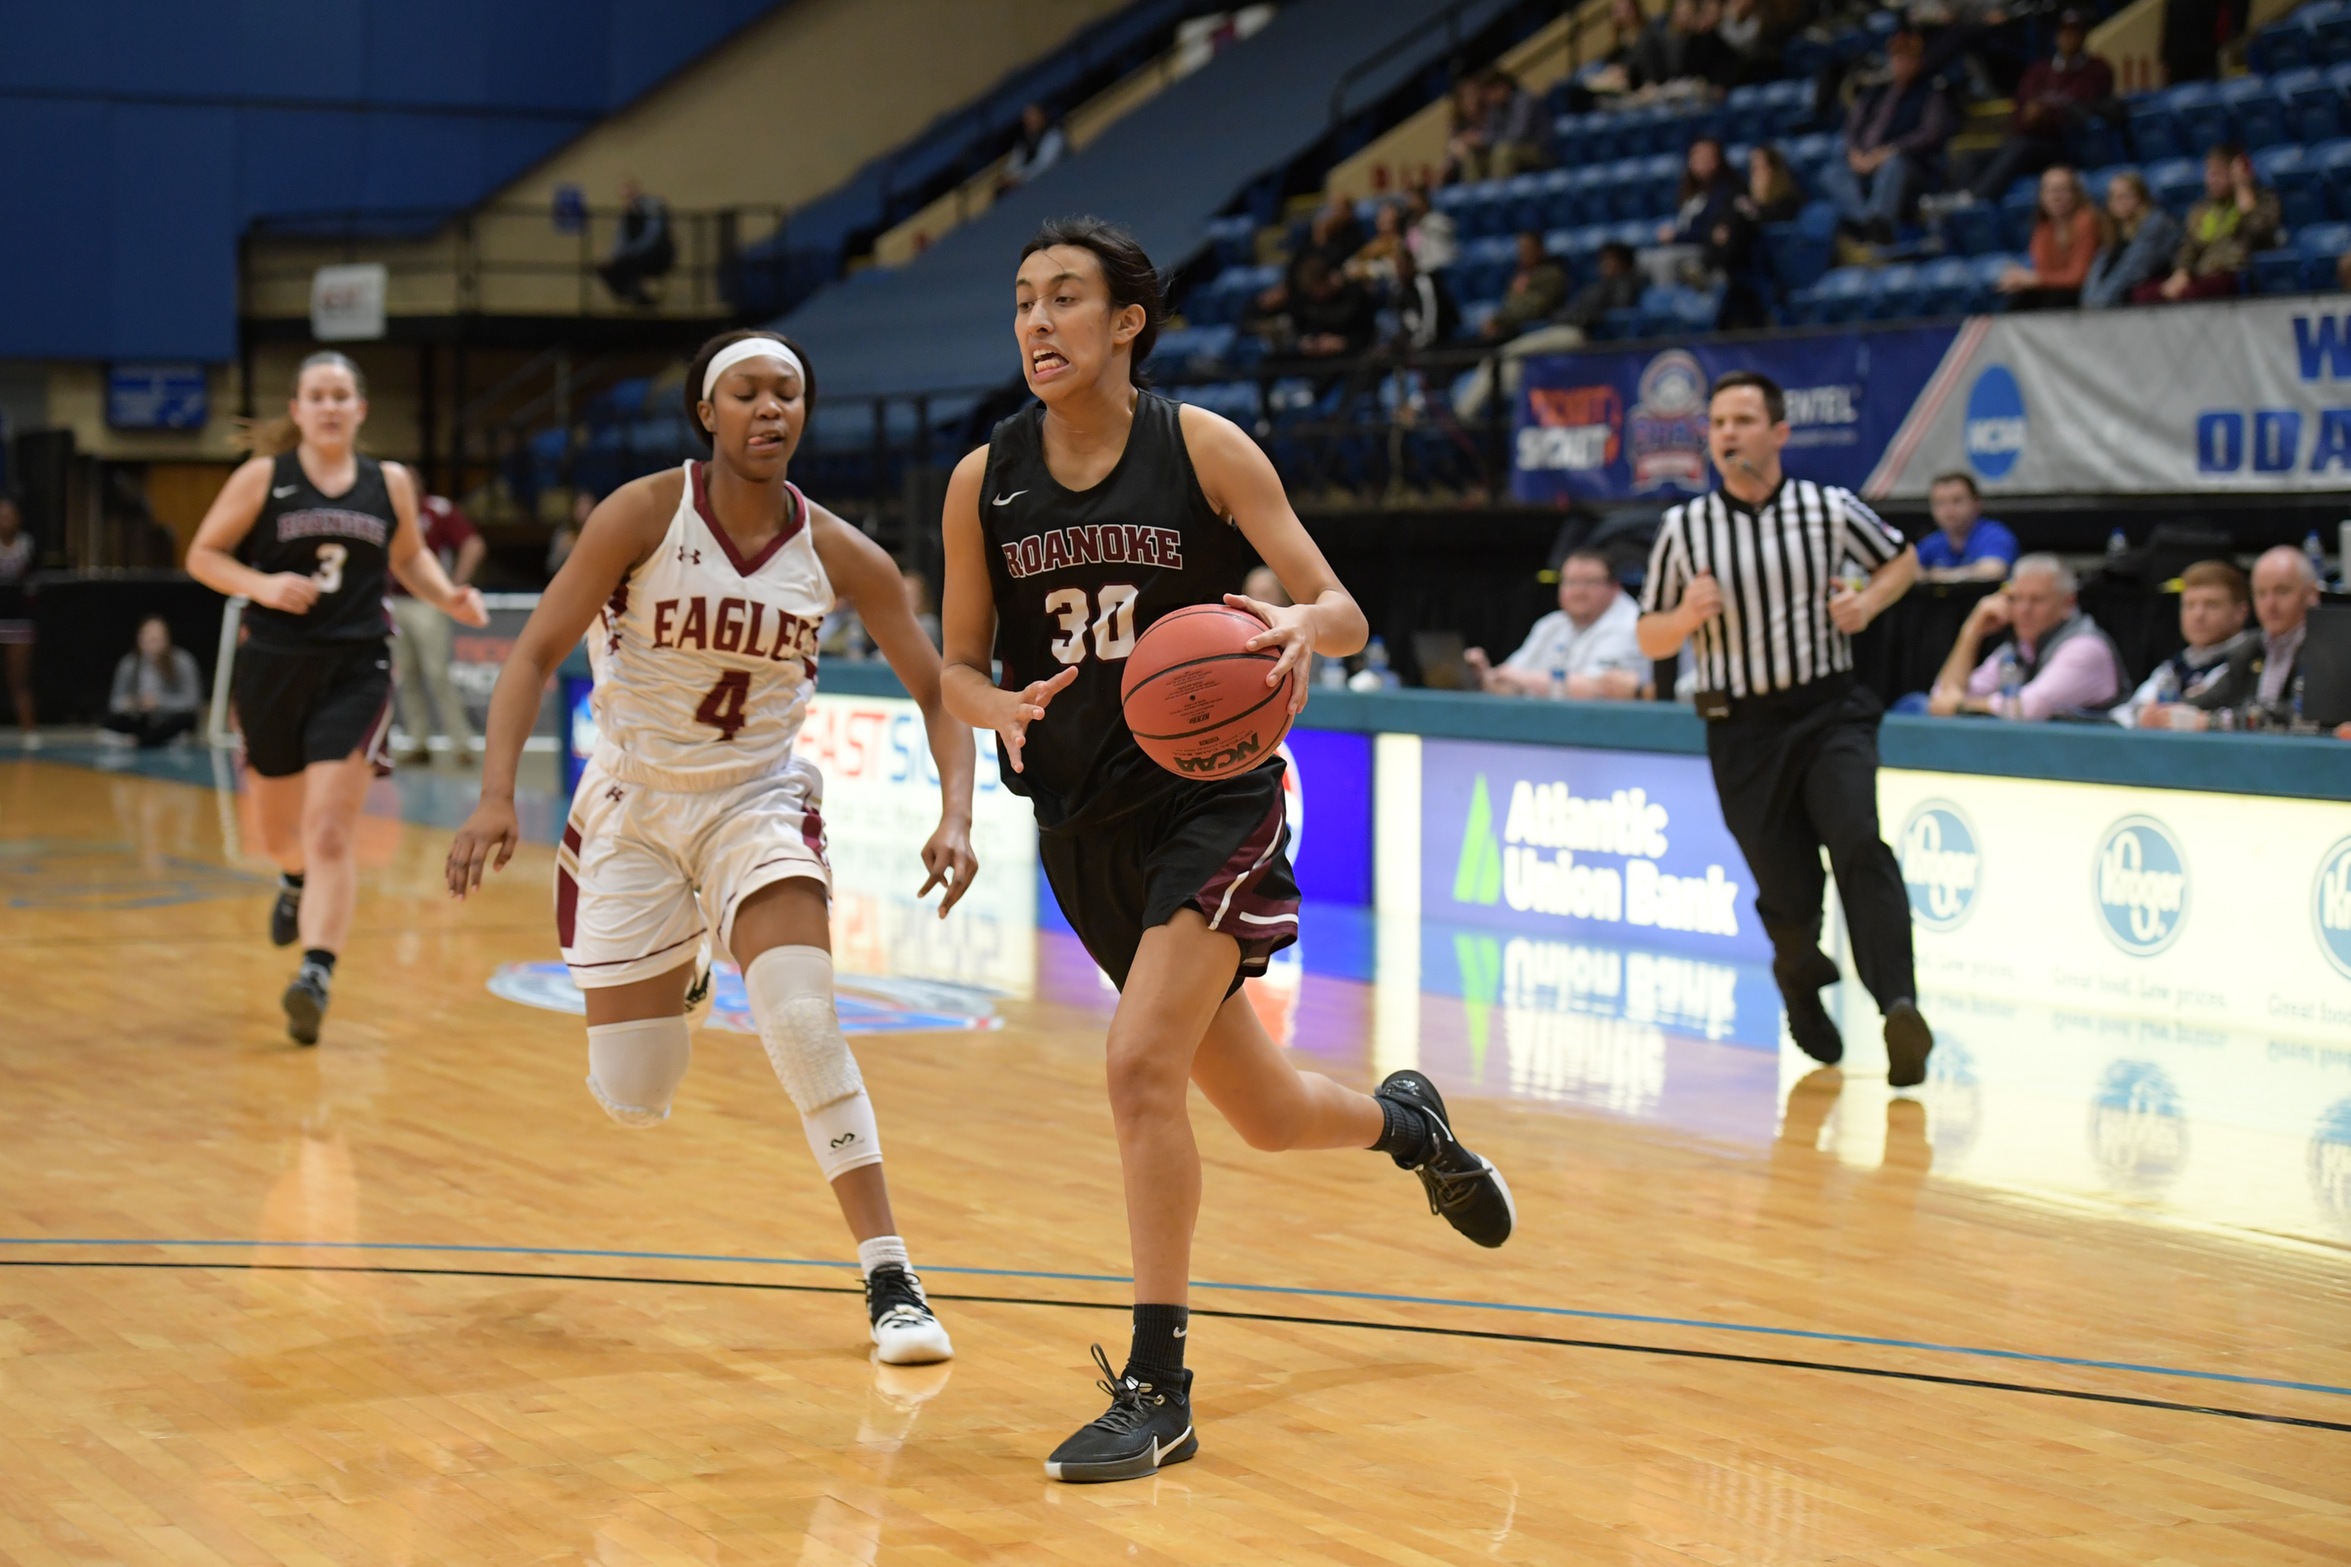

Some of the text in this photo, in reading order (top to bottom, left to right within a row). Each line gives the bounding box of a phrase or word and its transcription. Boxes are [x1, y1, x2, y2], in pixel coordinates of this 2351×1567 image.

[315, 542, 348, 594] 3
[1001, 524, 1183, 579] ROANOKE
[1045, 584, 1140, 664] 30
[695, 670, 751, 741] 4
[1173, 732, 1260, 773] NCAA
[1504, 780, 1669, 858] Atlantic
[1504, 846, 1738, 936] Union Bank
[2100, 830, 2186, 942] Kroger
